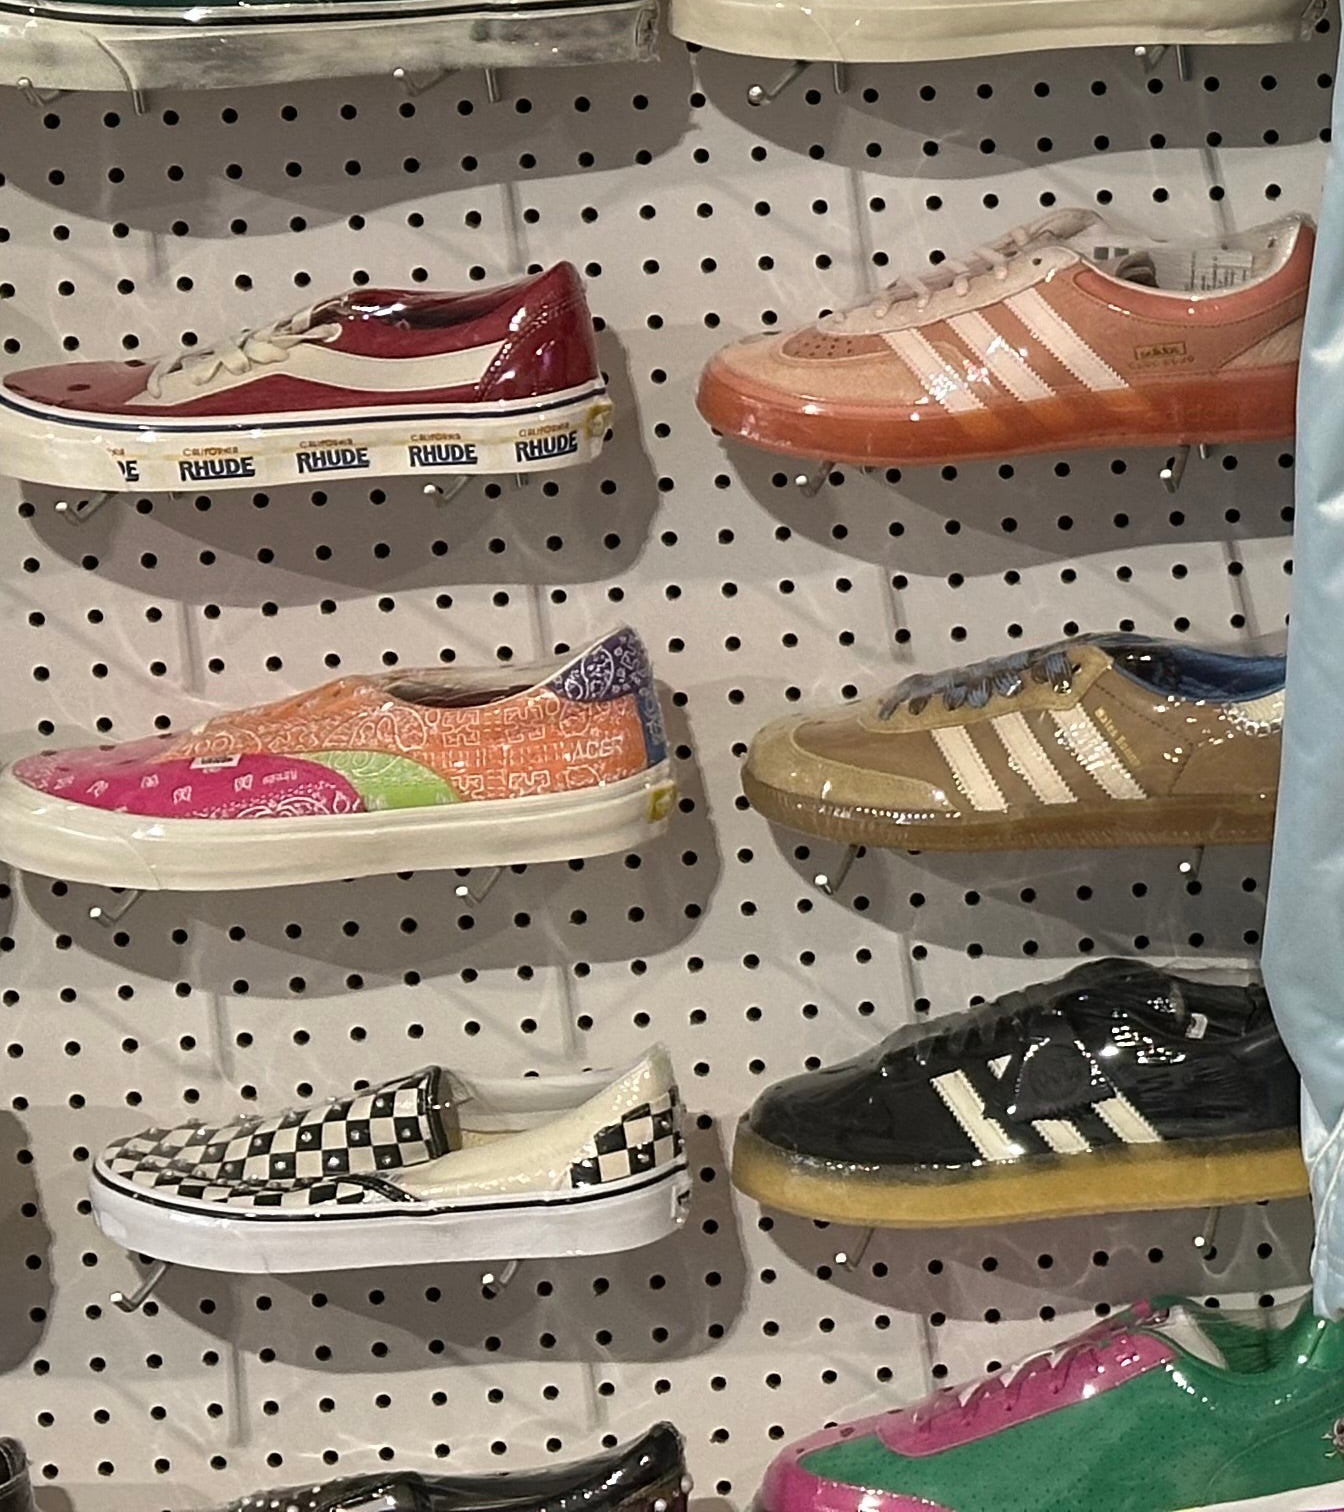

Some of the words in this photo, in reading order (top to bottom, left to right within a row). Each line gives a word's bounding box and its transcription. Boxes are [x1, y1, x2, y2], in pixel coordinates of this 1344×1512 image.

[408, 444, 478, 467] RHUDE
[515, 430, 578, 463] RHUDE
[178, 456, 255, 482] RHUDE
[296, 447, 370, 473] RHUDE
